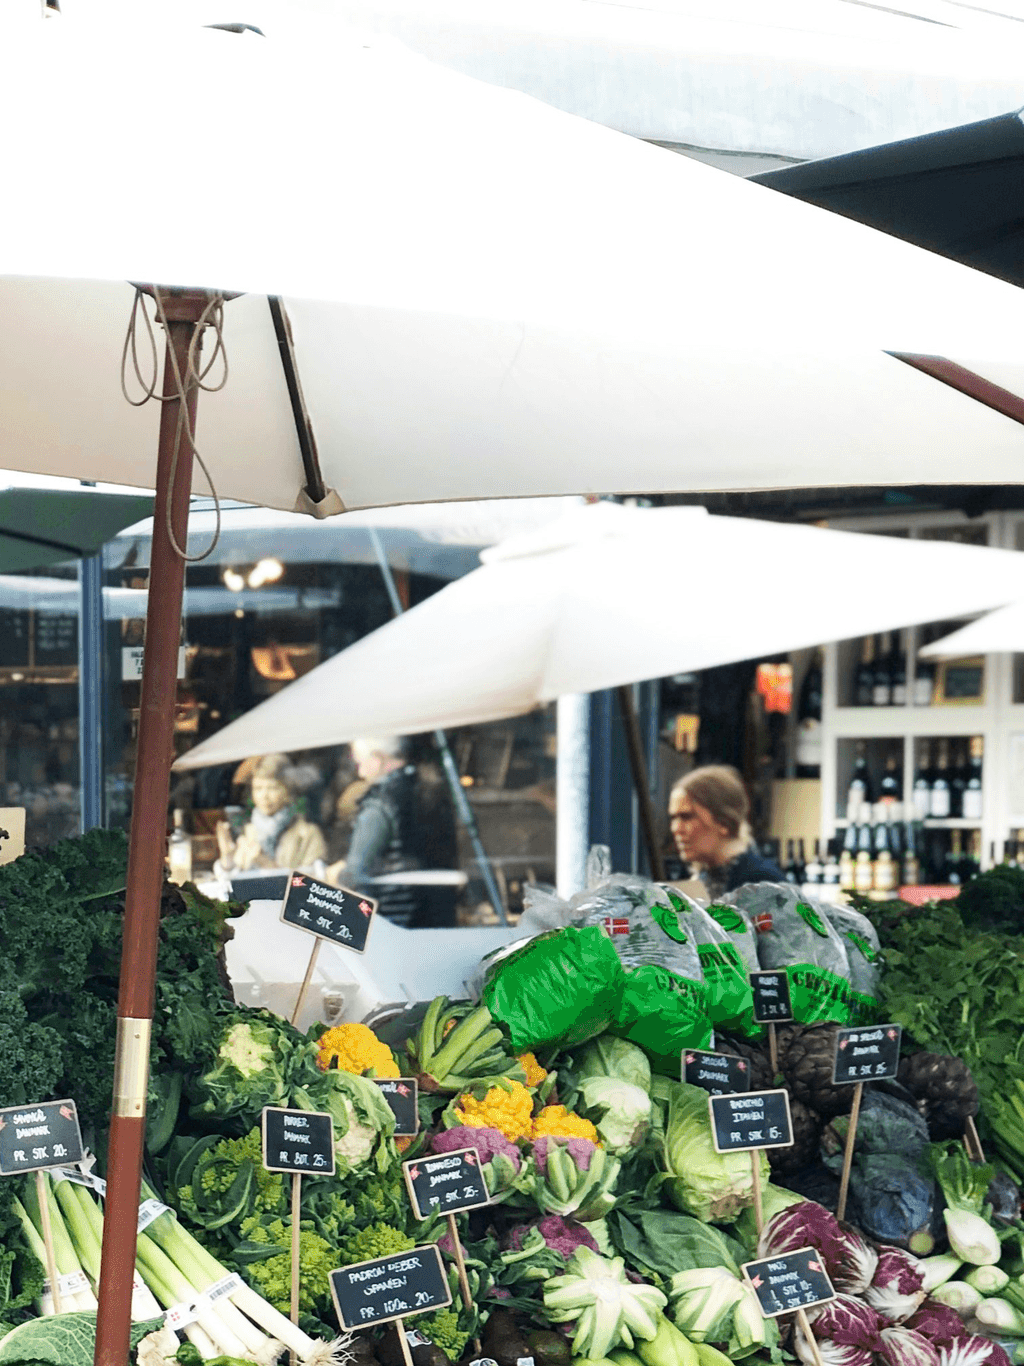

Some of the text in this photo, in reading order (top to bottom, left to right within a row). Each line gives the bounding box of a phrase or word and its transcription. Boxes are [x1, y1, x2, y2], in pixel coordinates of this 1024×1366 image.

[298, 908, 312, 921] PR.
[13, 1150, 29, 1162] PR.
[363, 1275, 408, 1296] SPANIEN
[359, 1306, 380, 1319] PR.
